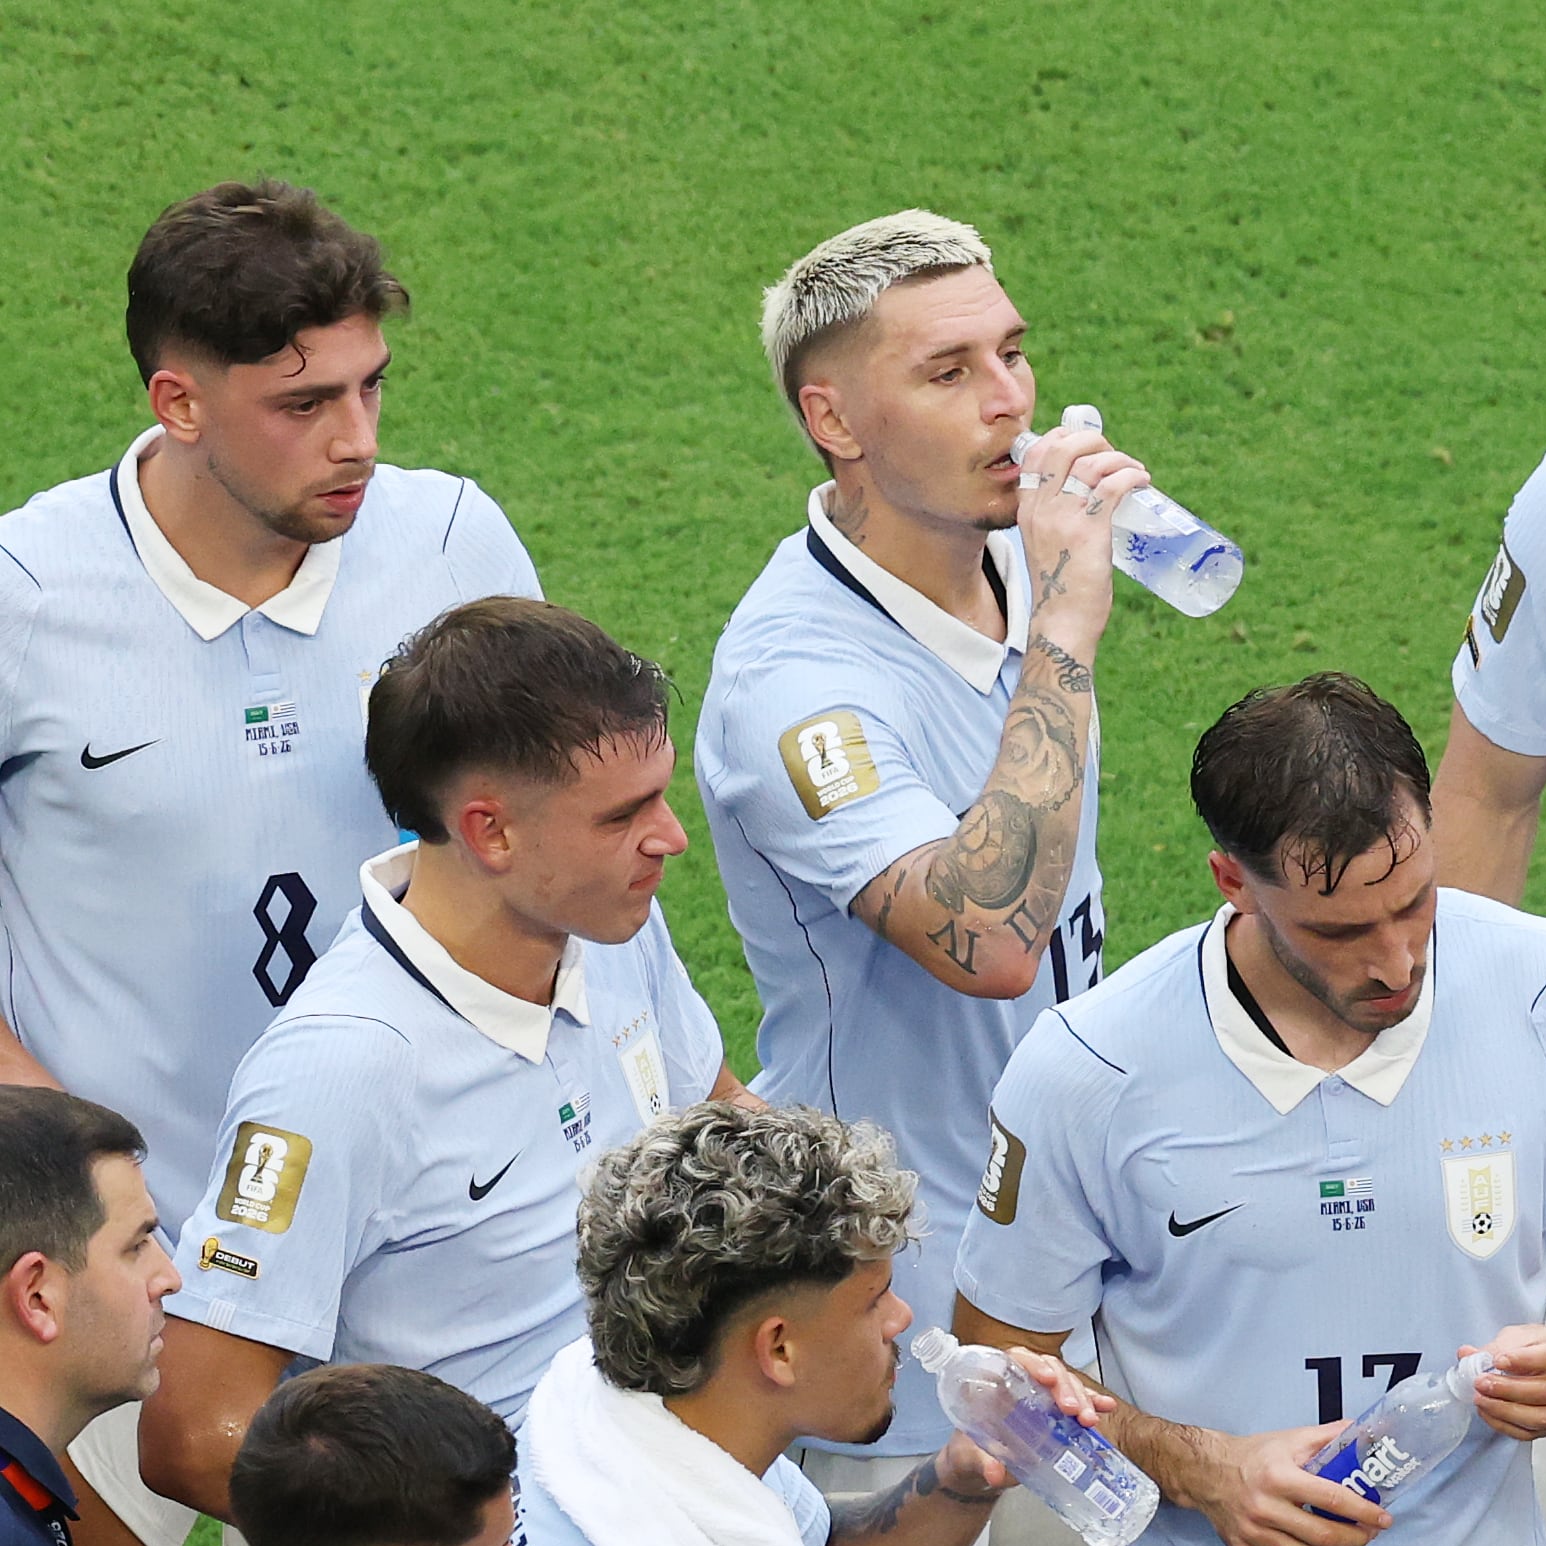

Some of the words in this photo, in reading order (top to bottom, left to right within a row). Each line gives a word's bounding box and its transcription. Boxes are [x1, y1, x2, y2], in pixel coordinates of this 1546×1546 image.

[819, 782, 859, 807] 2026
[252, 871, 319, 1008] 8
[1049, 892, 1104, 1005] 13
[231, 1205, 268, 1222] 2026
[1320, 1200, 1353, 1216] MIAMI,
[1357, 1198, 1375, 1212] USA
[215, 1252, 255, 1270] DEBUT
